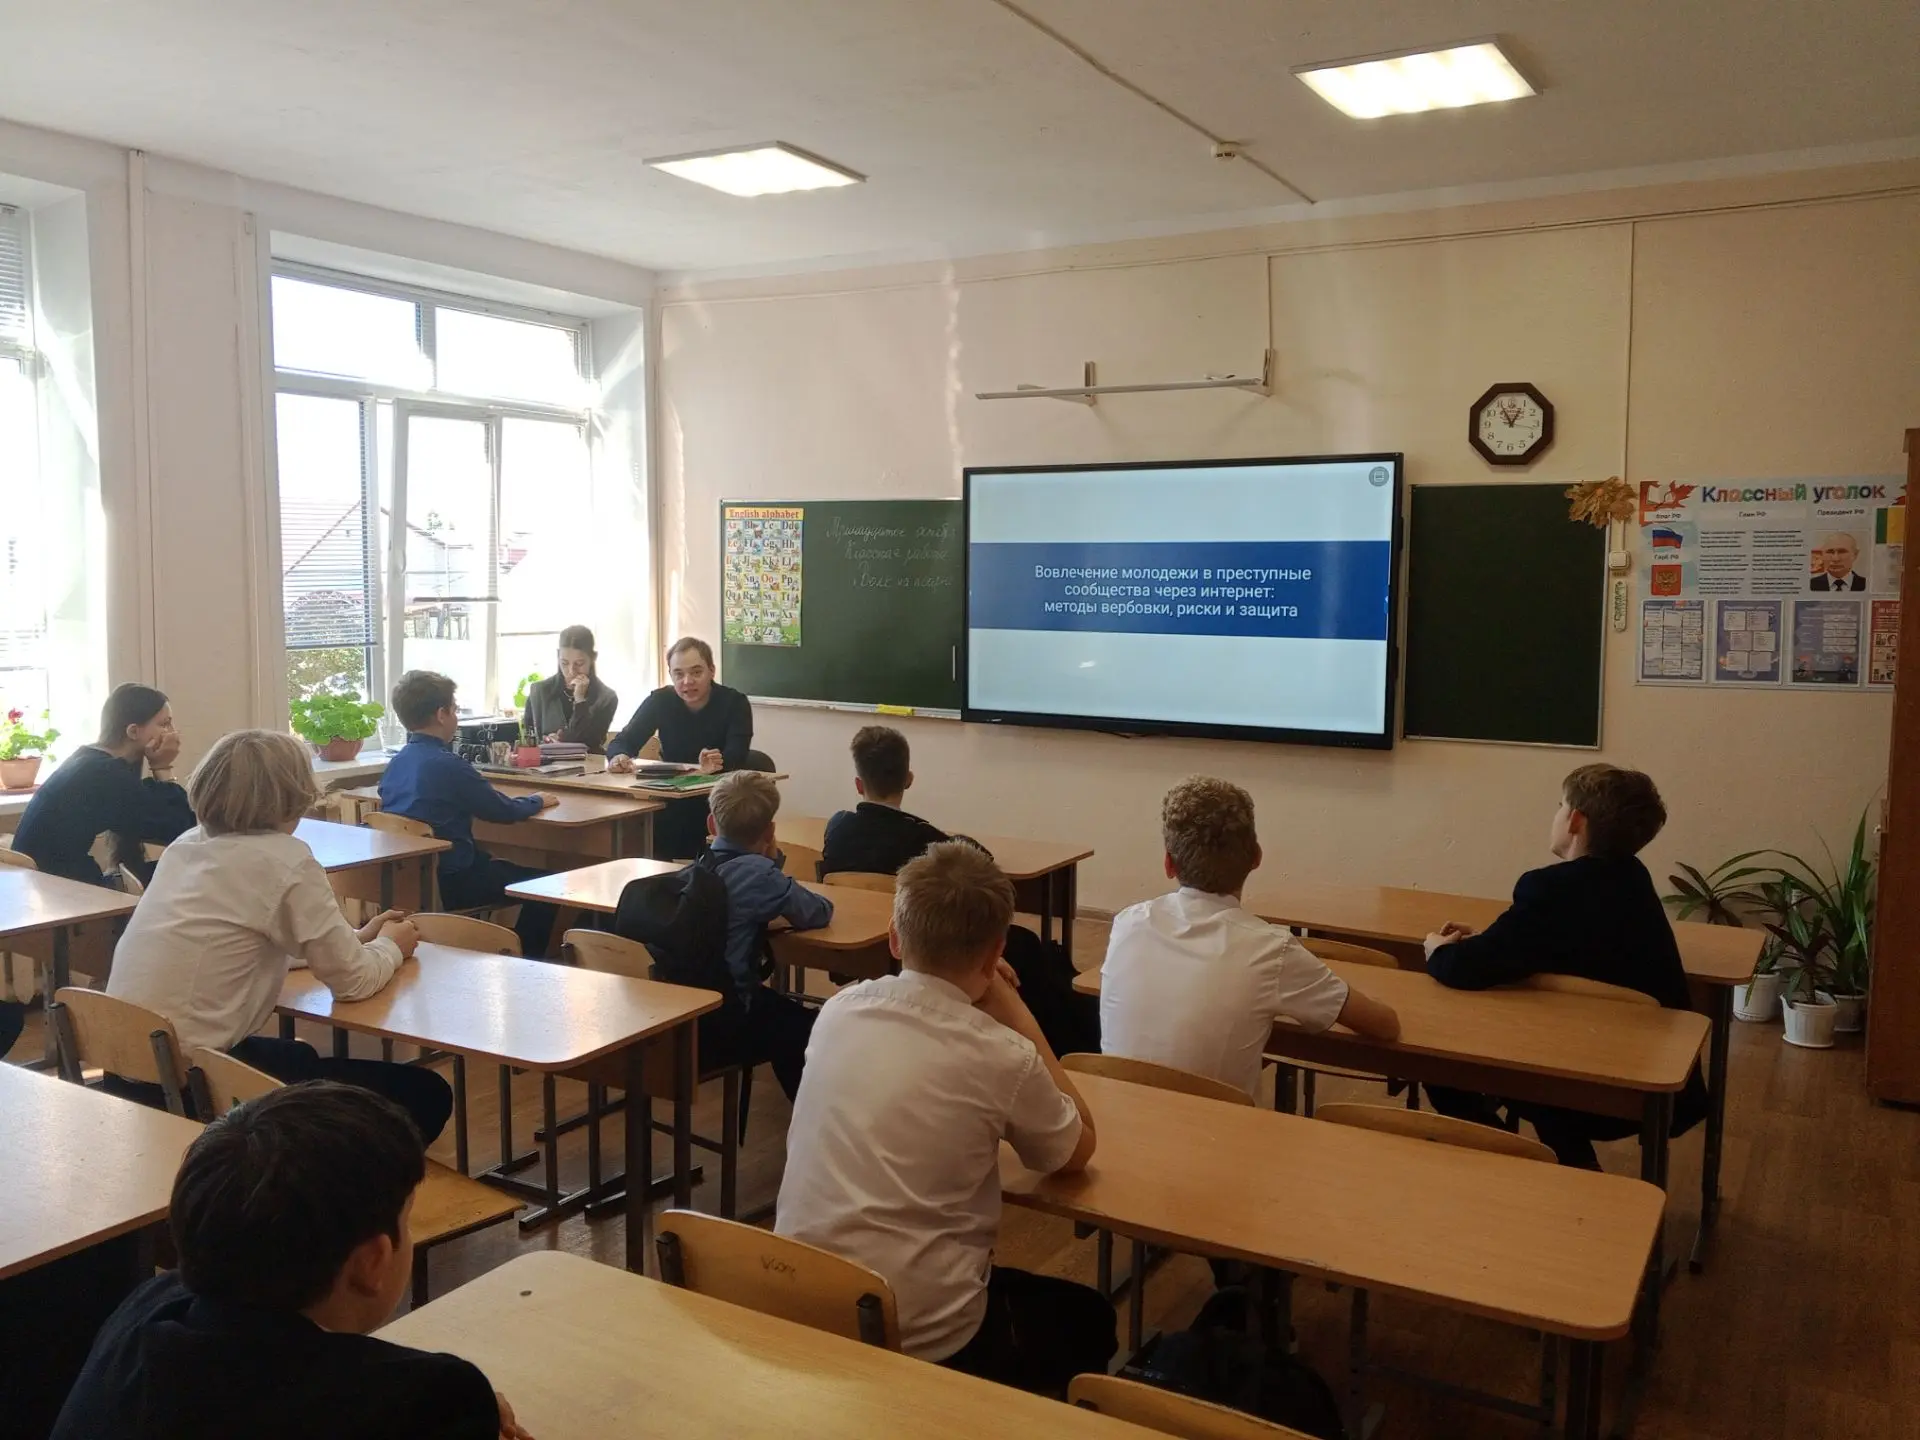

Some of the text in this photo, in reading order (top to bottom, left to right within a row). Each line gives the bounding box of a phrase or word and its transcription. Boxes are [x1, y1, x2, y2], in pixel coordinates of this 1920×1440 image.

[1702, 484, 1886, 503] Классный уголок
[728, 509, 800, 519] English alphabet
[1035, 565, 1311, 583] Вовлечение молодежи в преступные
[1064, 582, 1275, 601] сообщества через интернет:
[1044, 600, 1298, 619] методы вербовки, риски и защита
